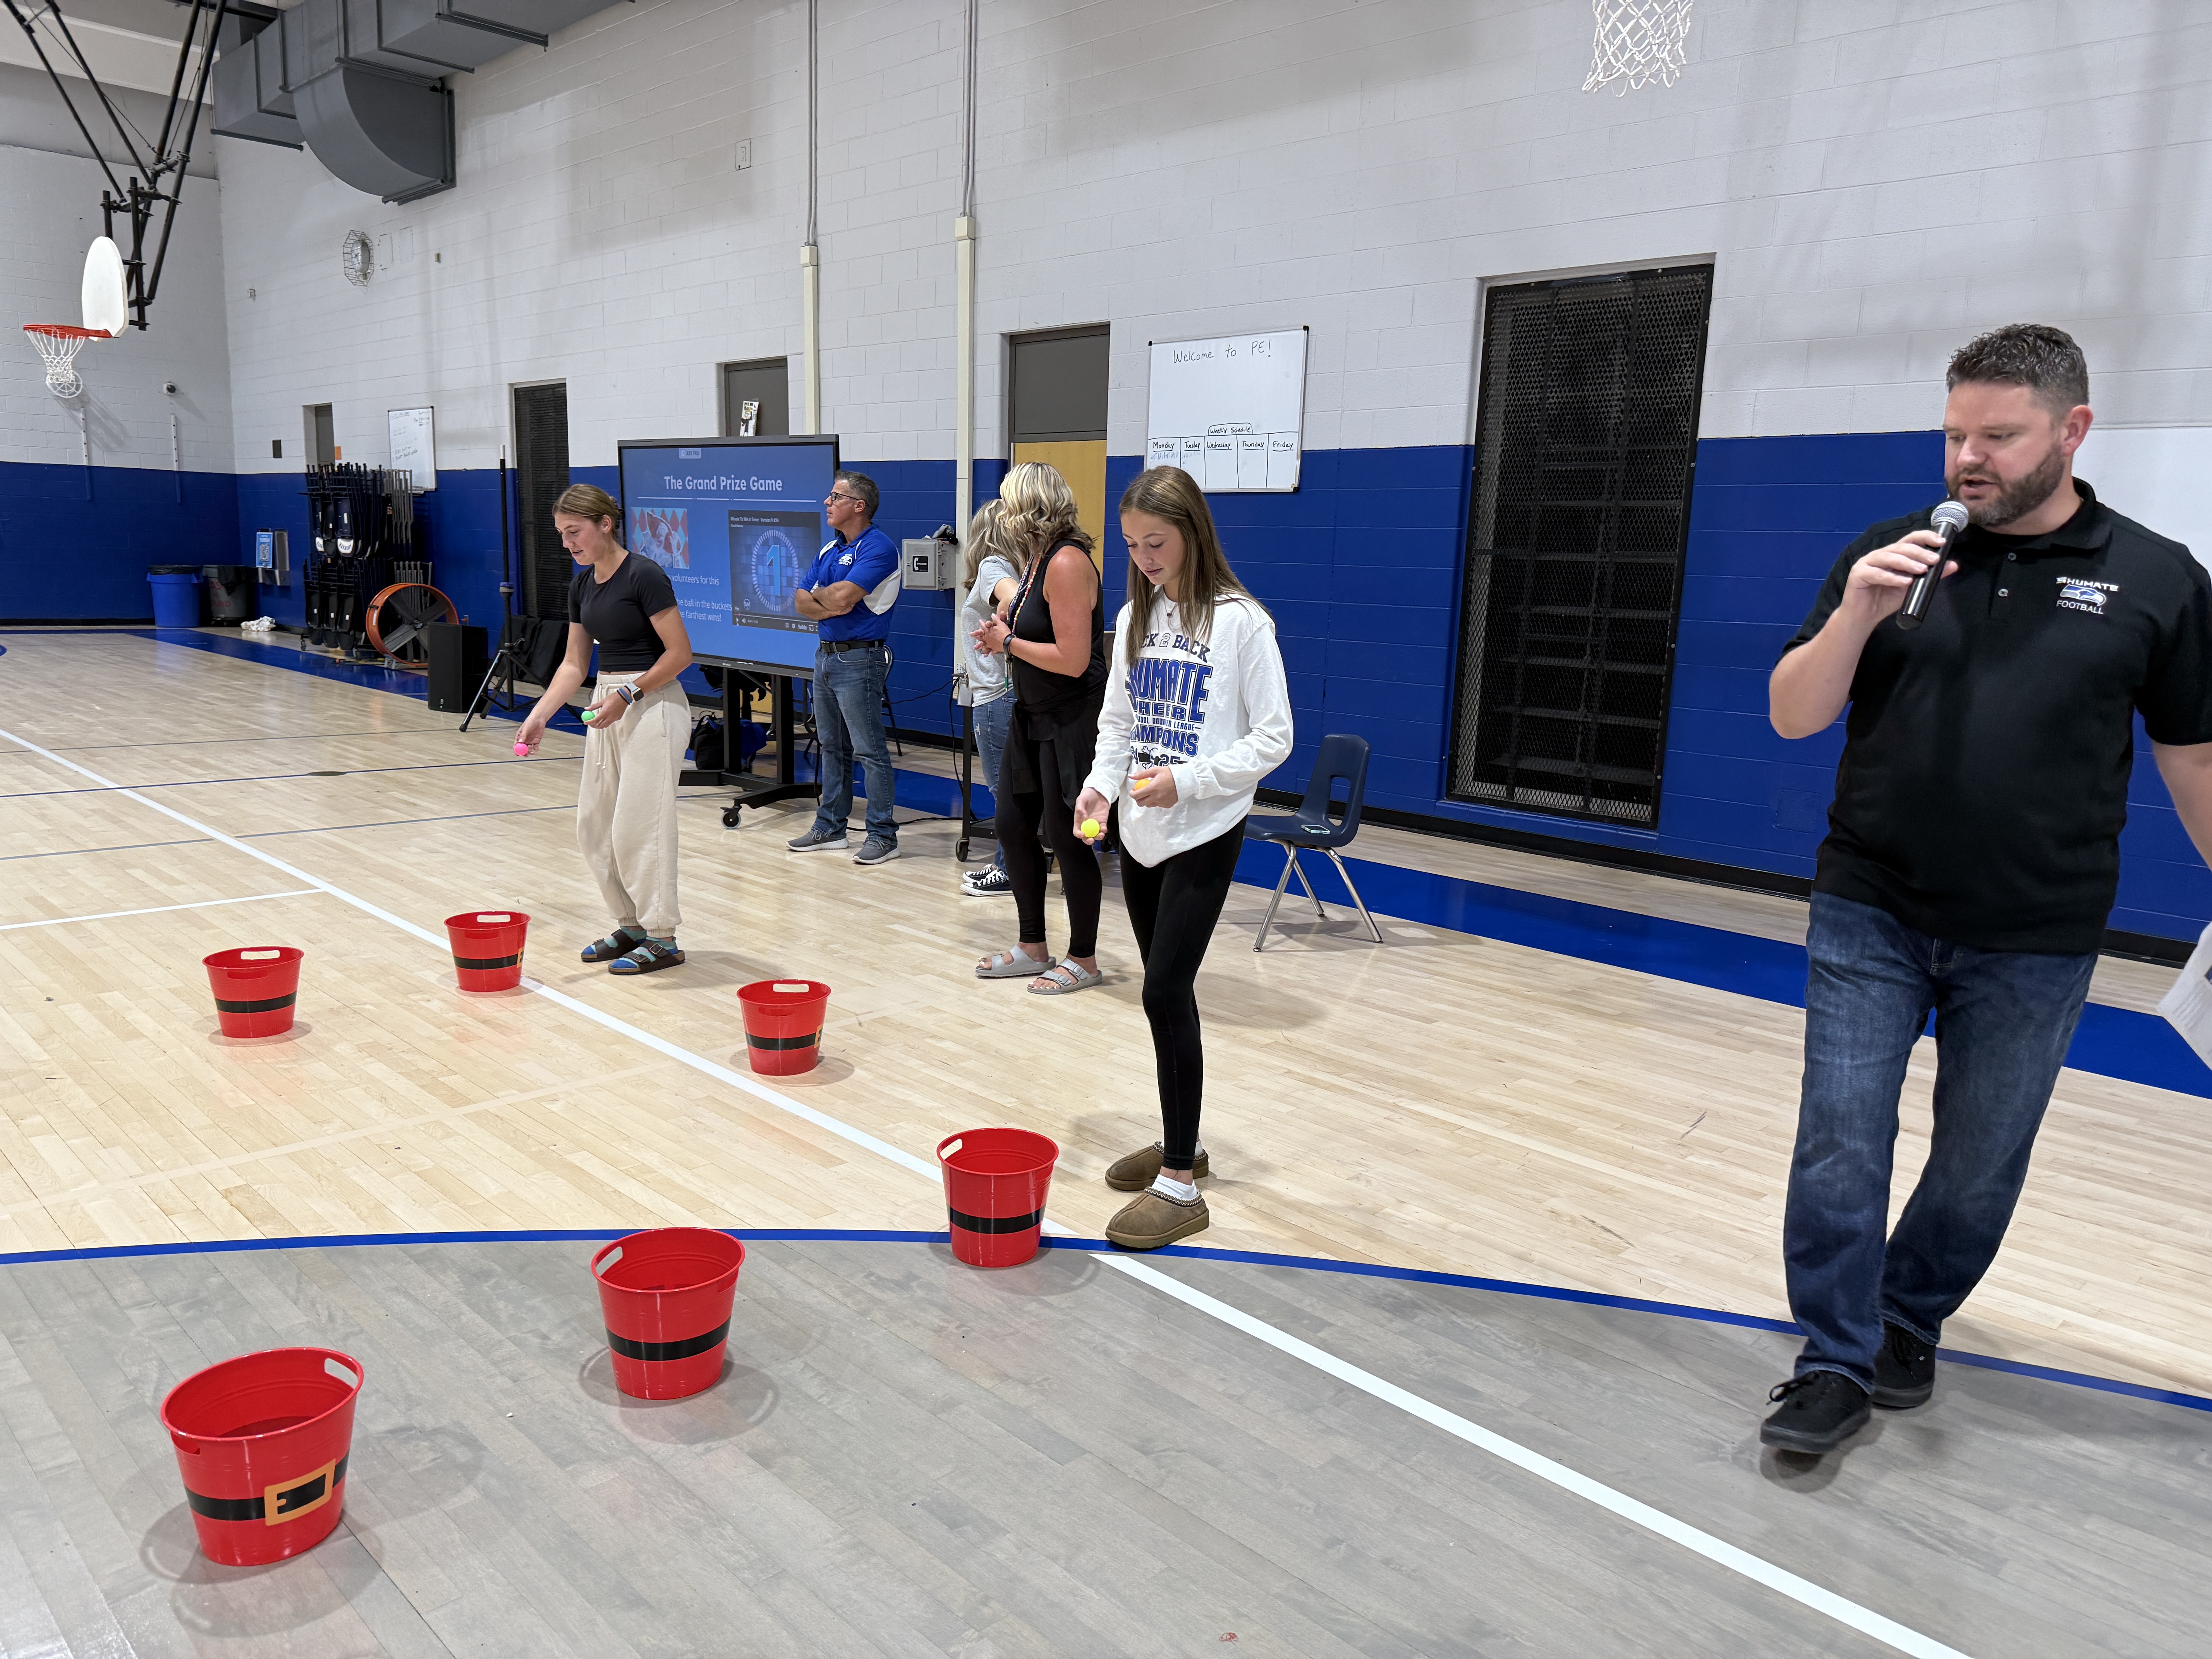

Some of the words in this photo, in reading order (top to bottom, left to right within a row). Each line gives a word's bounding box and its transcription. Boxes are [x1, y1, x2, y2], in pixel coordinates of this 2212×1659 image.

[1174, 350, 1214, 364] Welcome
[1225, 344, 1237, 358] to
[1251, 339, 1271, 357] PE!
[664, 475, 683, 489] The
[685, 475, 717, 490] Grand
[720, 474, 747, 490] Prize
[750, 476, 782, 491] Game
[766, 544, 781, 597] 1
[672, 574, 699, 584] volunteers
[709, 577, 720, 585] this
[2056, 577, 2119, 592] SHUMATE
[684, 598, 694, 607] ball
[701, 600, 710, 609] the
[711, 601, 732, 611] buckets
[2056, 600, 2104, 615] FOOTBALL
[685, 610, 706, 620] farthest
[707, 613, 721, 622] wins!
[1140, 633, 1159, 649] CK
[1159, 633, 1171, 647] 2
[1172, 634, 1211, 663] BACK
[1138, 701, 1187, 721] HEER
[1173, 721, 1195, 731] LEAGUE
